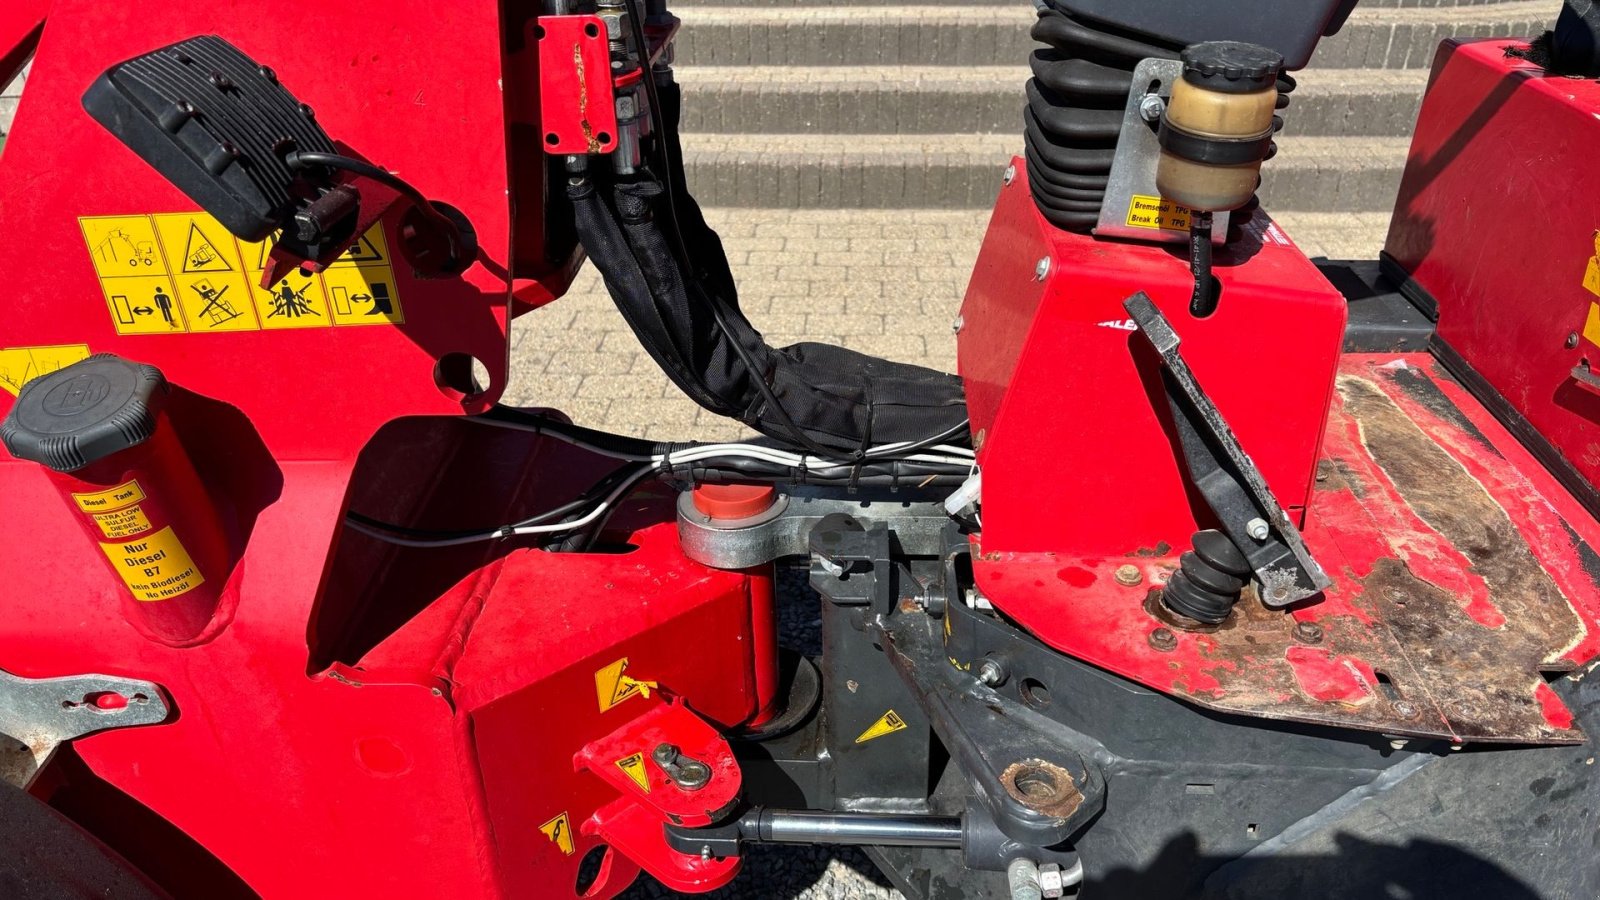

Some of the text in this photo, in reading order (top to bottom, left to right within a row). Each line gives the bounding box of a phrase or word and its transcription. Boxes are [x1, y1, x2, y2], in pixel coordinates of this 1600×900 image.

[1175, 206, 1189, 215] TPG
[1131, 214, 1151, 224] Break
[1171, 218, 1186, 227] TPG
[83, 490, 135, 506] Diesel Tank
[94, 507, 140, 521] ULTRA LOW
[105, 515, 137, 526] SULFUR
[110, 522, 139, 532] DIESEL
[128, 523, 149, 534] ONLY
[124, 542, 148, 554] Nur
[124, 549, 167, 567] Diesel
[144, 566, 161, 578] B7
[150, 567, 194, 589] Biodiesel
[145, 581, 190, 599] No Heizöl
